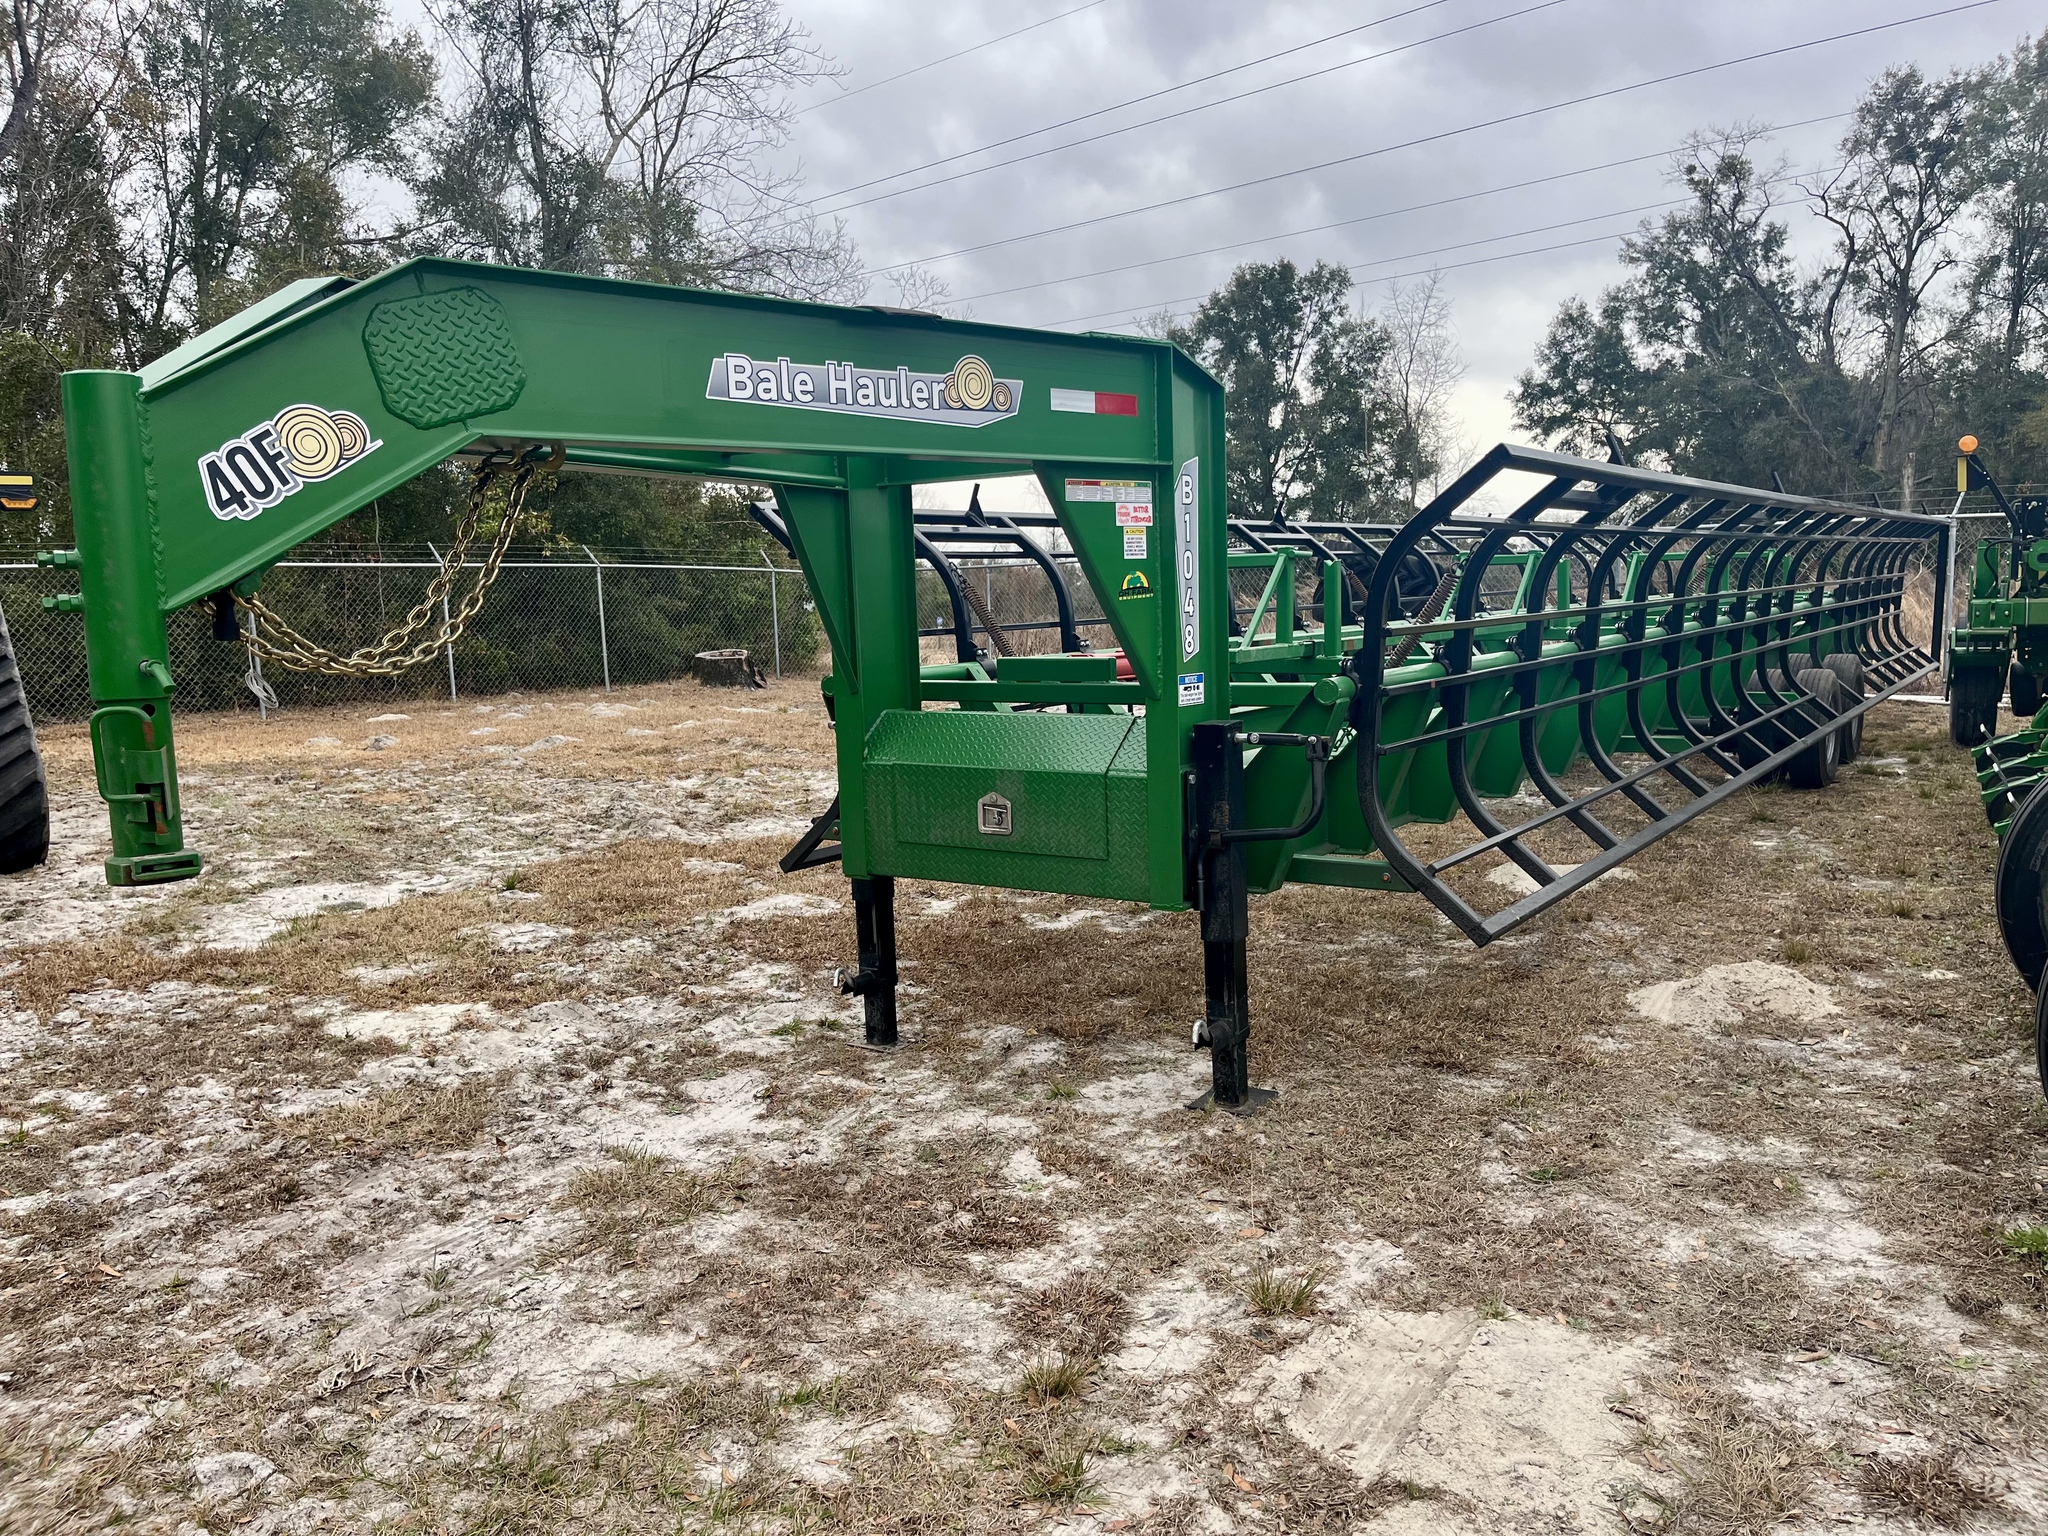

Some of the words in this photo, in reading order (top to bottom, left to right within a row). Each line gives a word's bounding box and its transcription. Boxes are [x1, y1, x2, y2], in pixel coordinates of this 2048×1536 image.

[725, 354, 815, 405] Bale
[826, 361, 946, 411] Hauler
[203, 426, 293, 514] 40F
[1132, 587, 1154, 595] FARM
[1181, 474, 1195, 654] B1048
